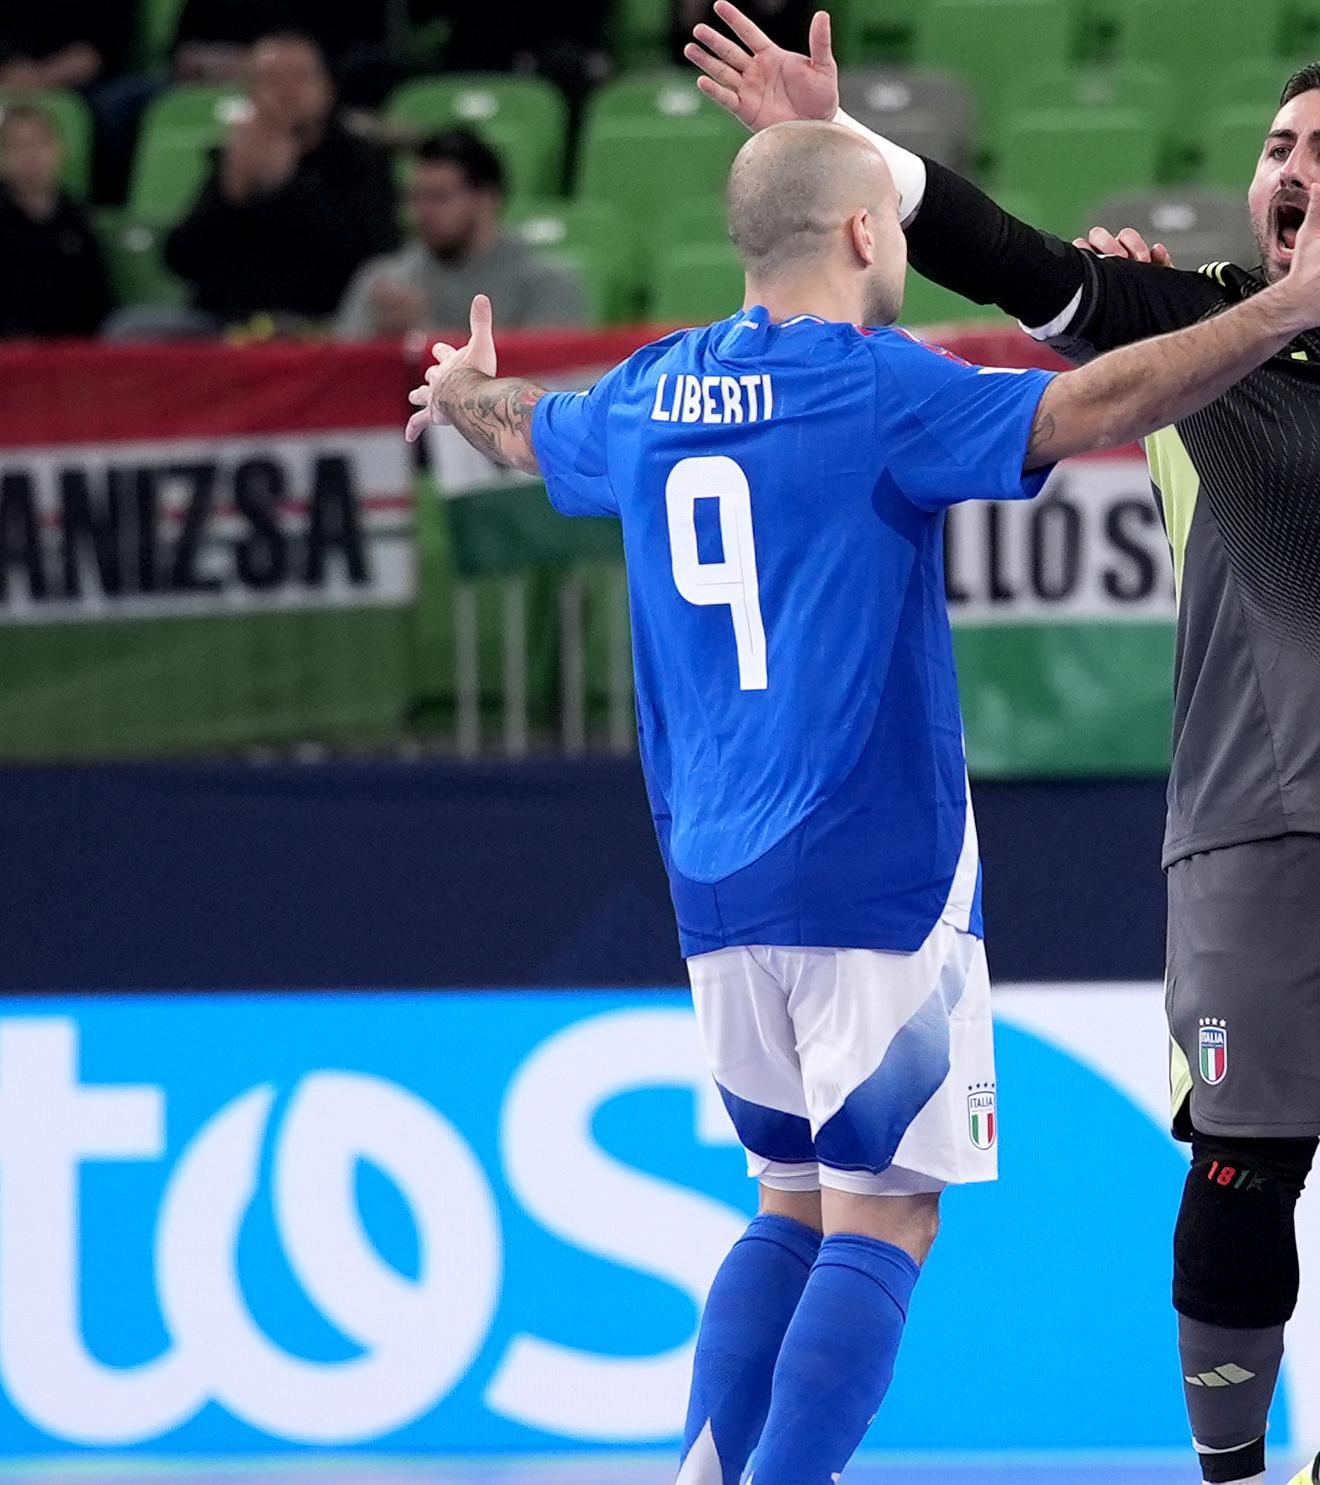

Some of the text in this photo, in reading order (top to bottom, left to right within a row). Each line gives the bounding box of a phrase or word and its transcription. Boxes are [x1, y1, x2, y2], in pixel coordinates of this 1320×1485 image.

[651, 373, 773, 424] LIBERTI
[0, 456, 372, 600] ANIZSA
[665, 455, 768, 691] 9
[970, 1096, 993, 1108] ITALIA
